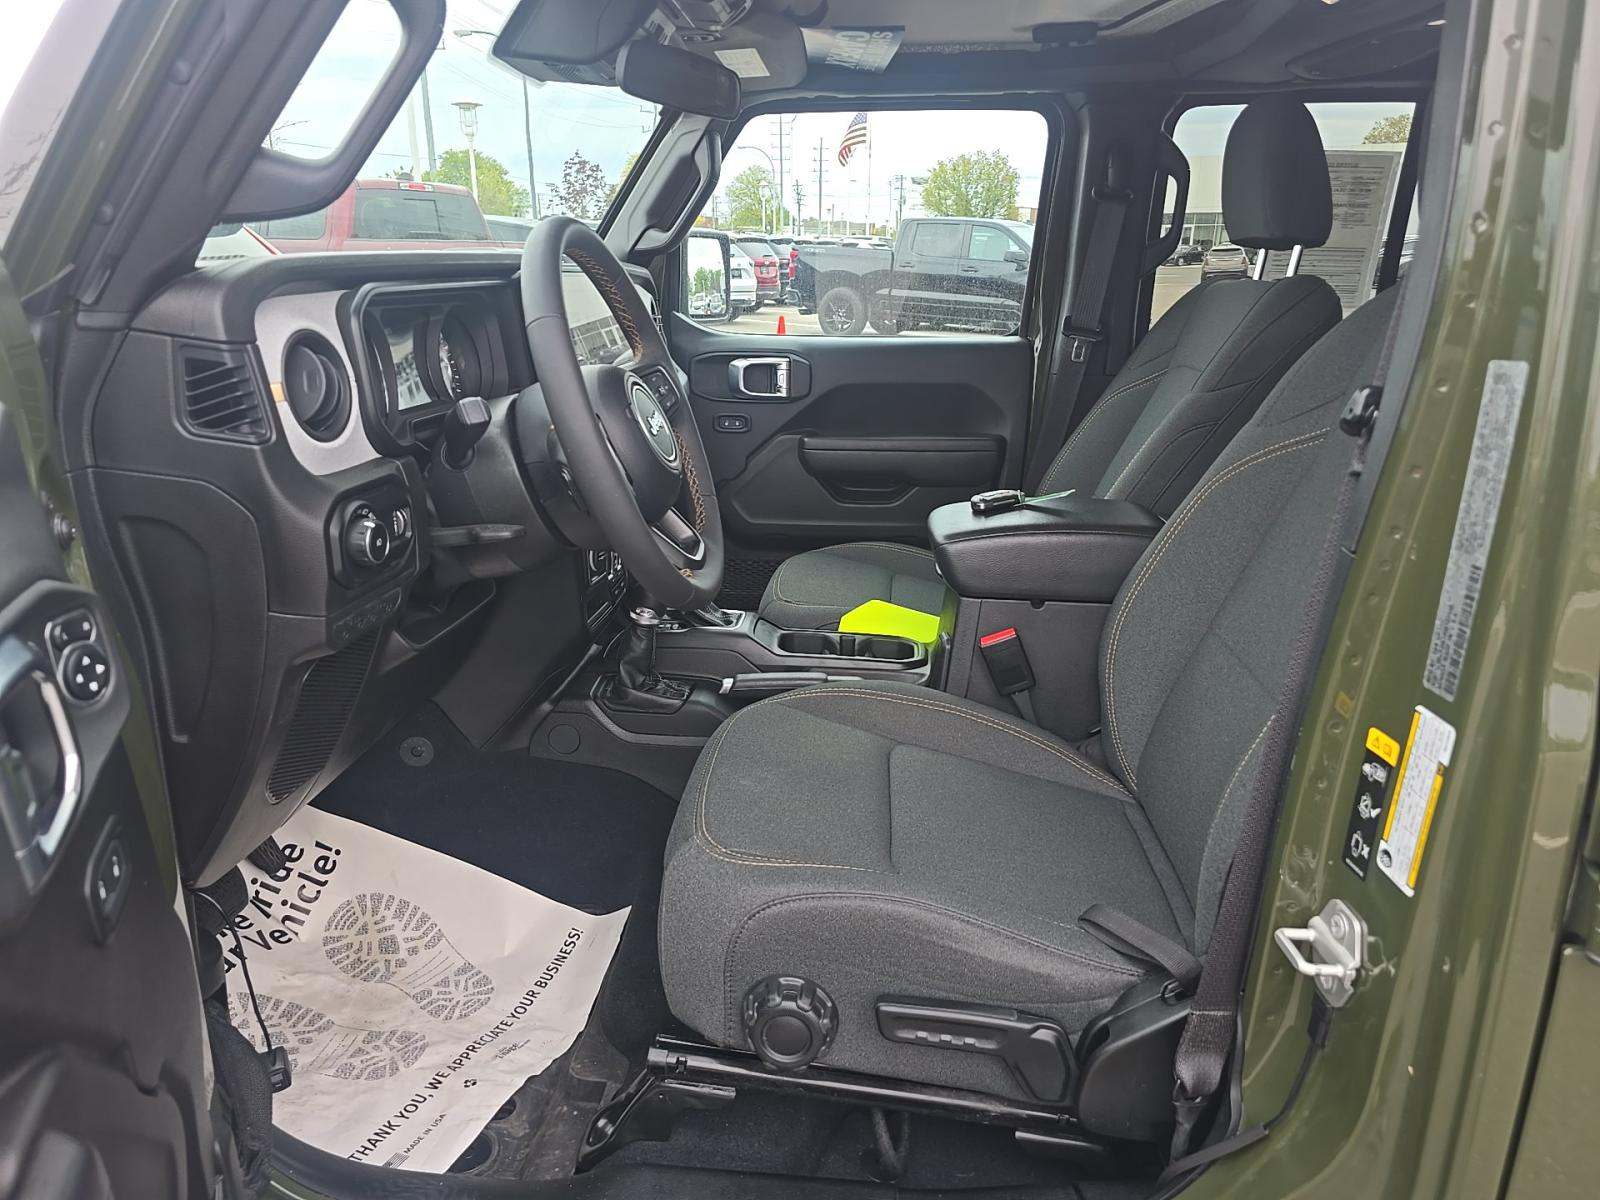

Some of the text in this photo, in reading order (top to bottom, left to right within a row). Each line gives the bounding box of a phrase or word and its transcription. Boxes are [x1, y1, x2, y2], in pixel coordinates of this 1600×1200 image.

[347, 1119, 402, 1161] THANK
[393, 1093, 434, 1120] YOU,
[424, 1070, 451, 1091] WE
[446, 1019, 515, 1072] APPRECIATE
[506, 989, 541, 1020] YOUR
[533, 927, 584, 989] BUSINESS!
[403, 1113, 447, 1154] MADE IN USA
